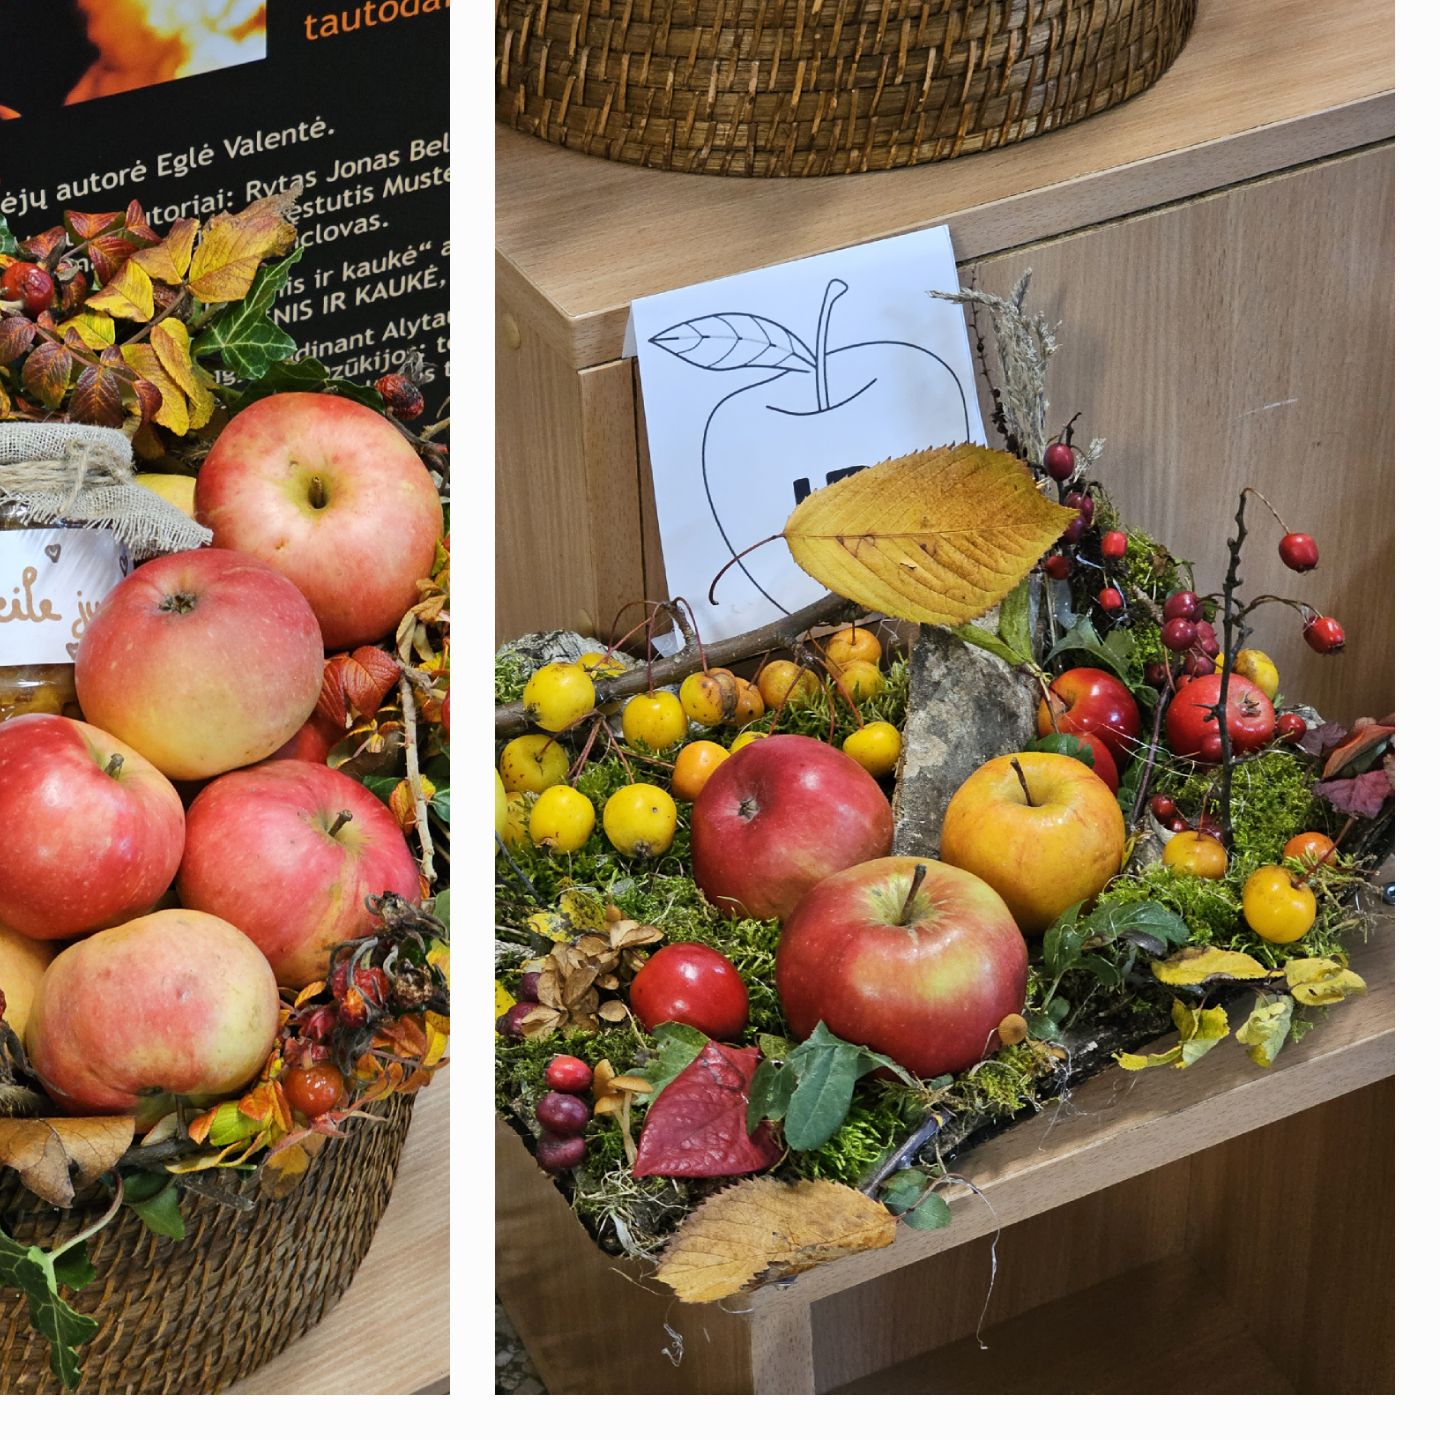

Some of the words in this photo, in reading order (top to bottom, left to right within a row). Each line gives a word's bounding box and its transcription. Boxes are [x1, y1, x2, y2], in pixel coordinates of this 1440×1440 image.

[56, 160, 147, 201] autorė
[157, 143, 215, 178] Eglė
[224, 116, 335, 159] Valentė.
[326, 150, 400, 182] Jonas
[285, 184, 375, 225] ęstutis
[266, 299, 314, 326] NIS
[322, 291, 347, 315] IR
[355, 264, 446, 306] KAUKĖ,
[314, 269, 335, 289] ir
[291, 329, 376, 362] dinant
